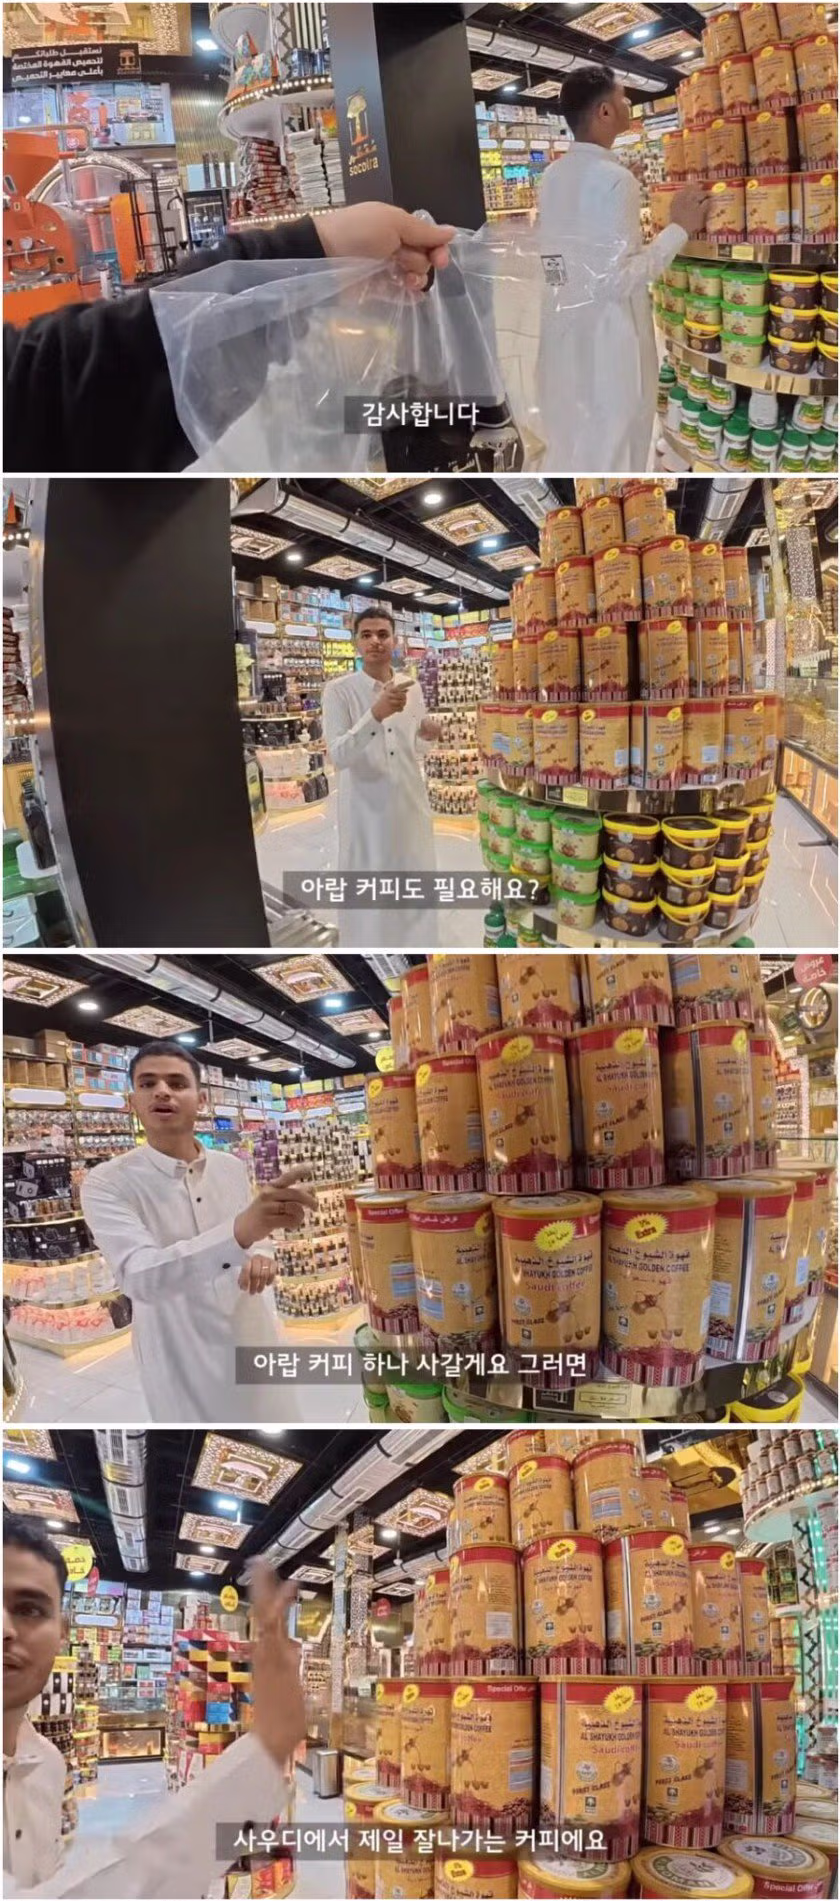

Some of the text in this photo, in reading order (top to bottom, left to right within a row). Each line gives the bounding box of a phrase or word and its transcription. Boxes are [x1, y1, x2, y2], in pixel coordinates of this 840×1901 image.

[349, 156, 379, 177] socotra
[638, 1262, 665, 1273] GOLDEN
[666, 1263, 690, 1273] COFFEE
[486, 1684, 513, 1693] Special
[592, 1744, 619, 1754] Saudi
[763, 1880, 796, 1893] Special
